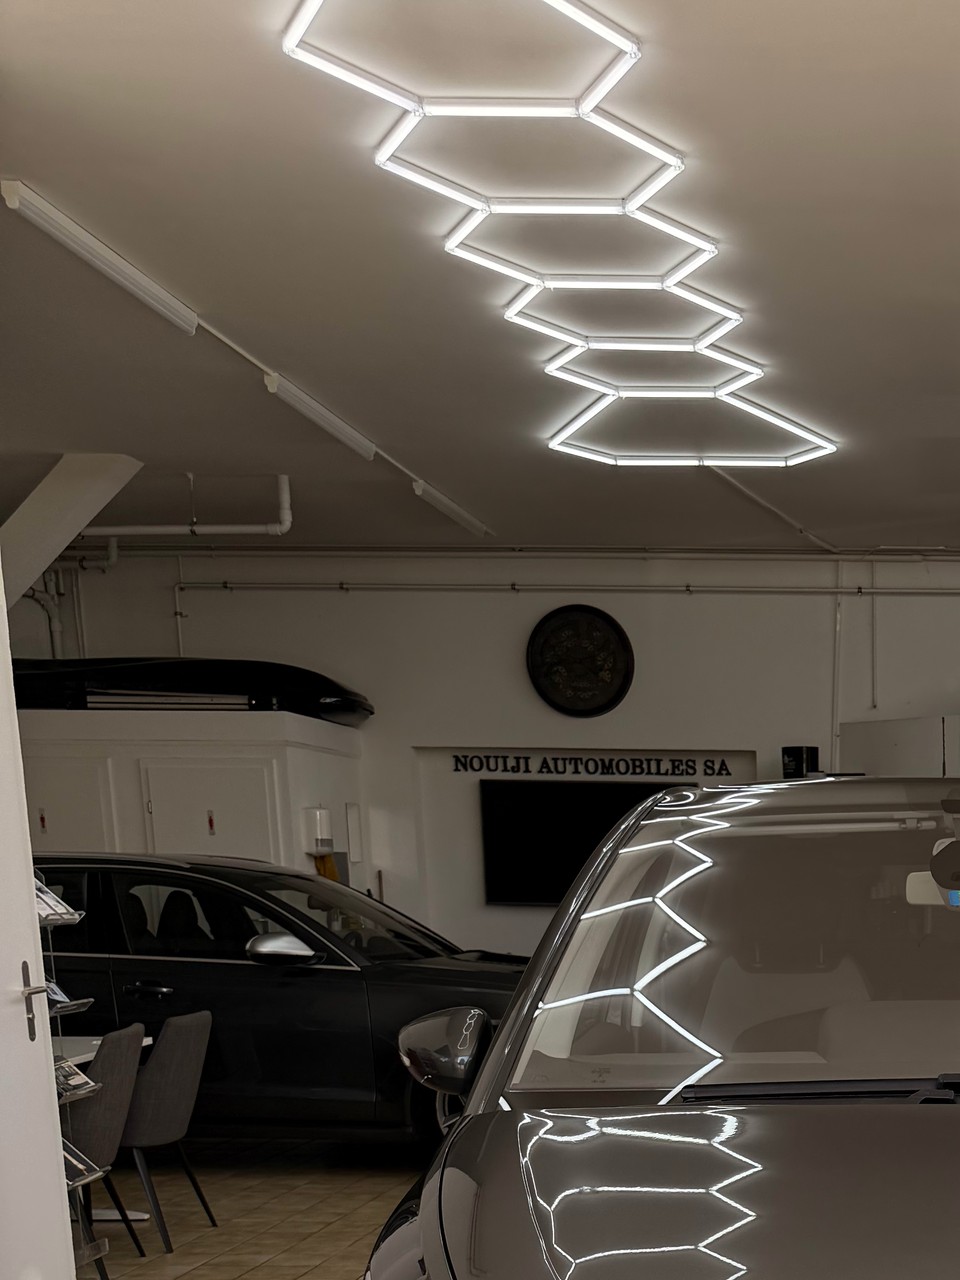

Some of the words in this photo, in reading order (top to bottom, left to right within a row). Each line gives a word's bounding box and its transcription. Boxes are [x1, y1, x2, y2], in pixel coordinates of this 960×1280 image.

[453, 755, 532, 774] NOUIJI
[537, 757, 697, 776] AUTOMOBILES
[703, 759, 732, 776] SA
